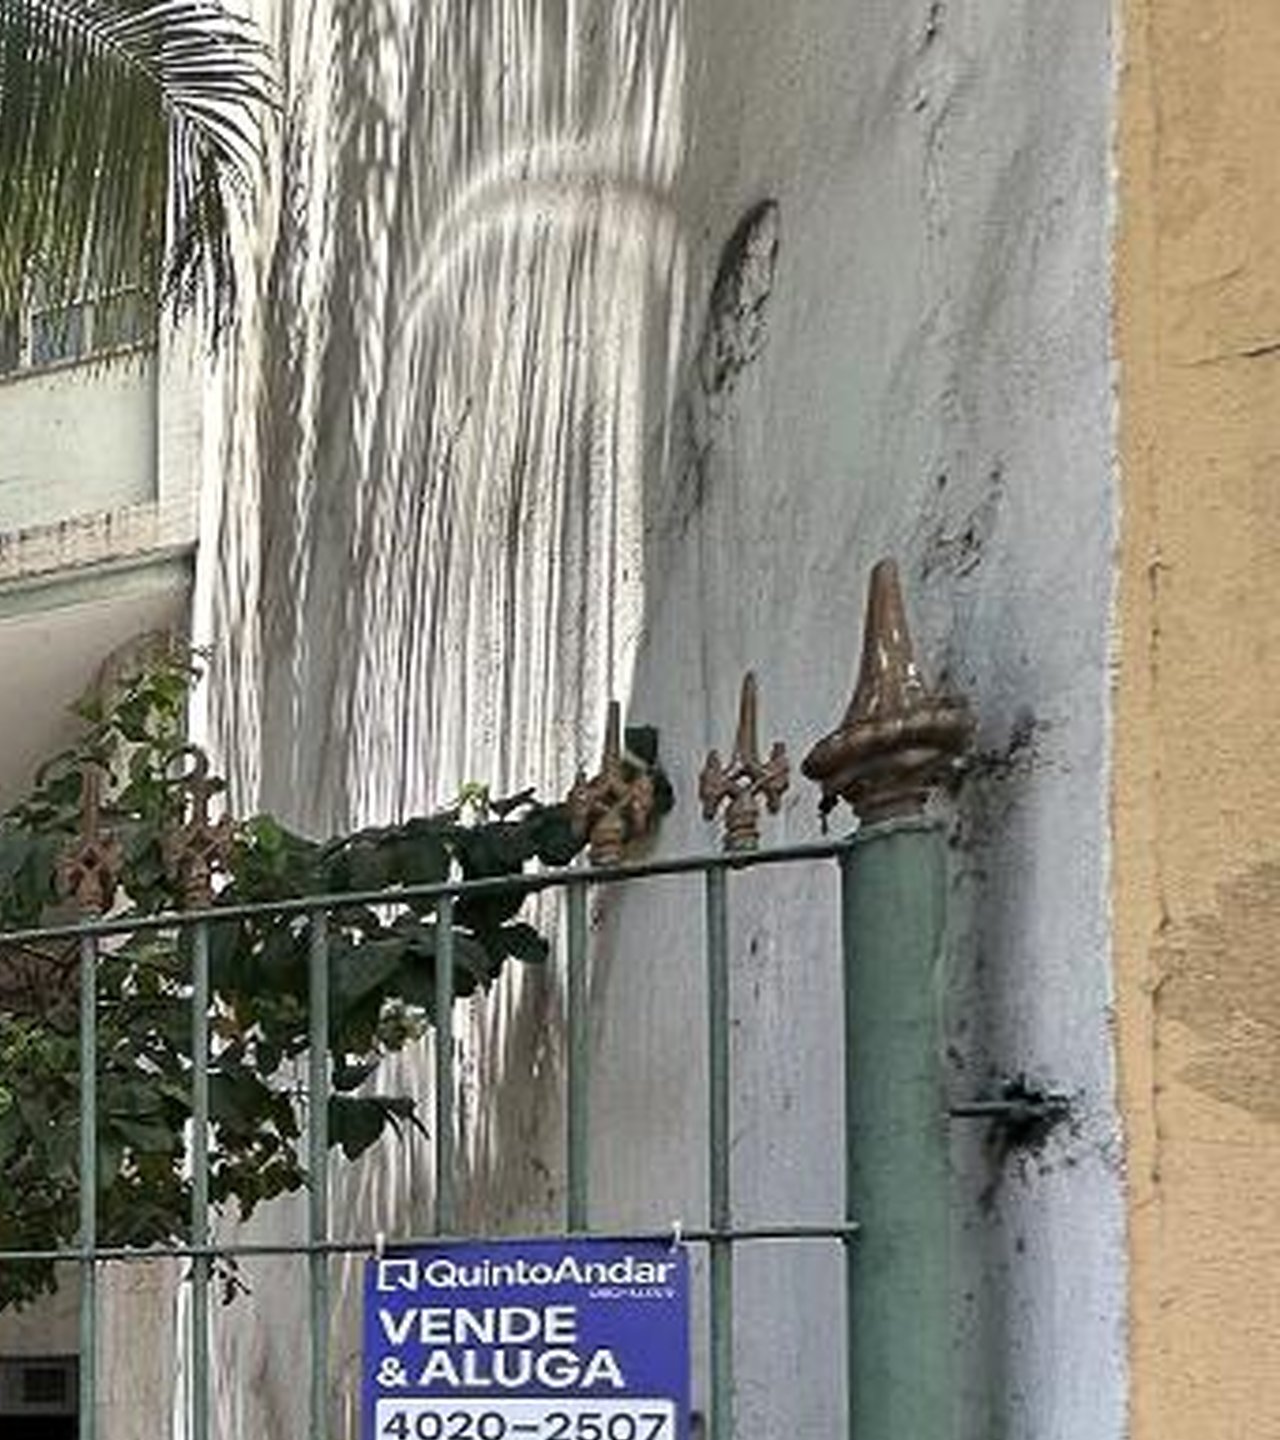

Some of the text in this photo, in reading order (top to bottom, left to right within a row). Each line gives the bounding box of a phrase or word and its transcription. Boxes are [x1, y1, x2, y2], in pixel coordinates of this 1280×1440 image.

[425, 1255, 676, 1288] QuintoAndar
[378, 1306, 578, 1345] VENDE
[376, 1349, 626, 1388] & ALUGA
